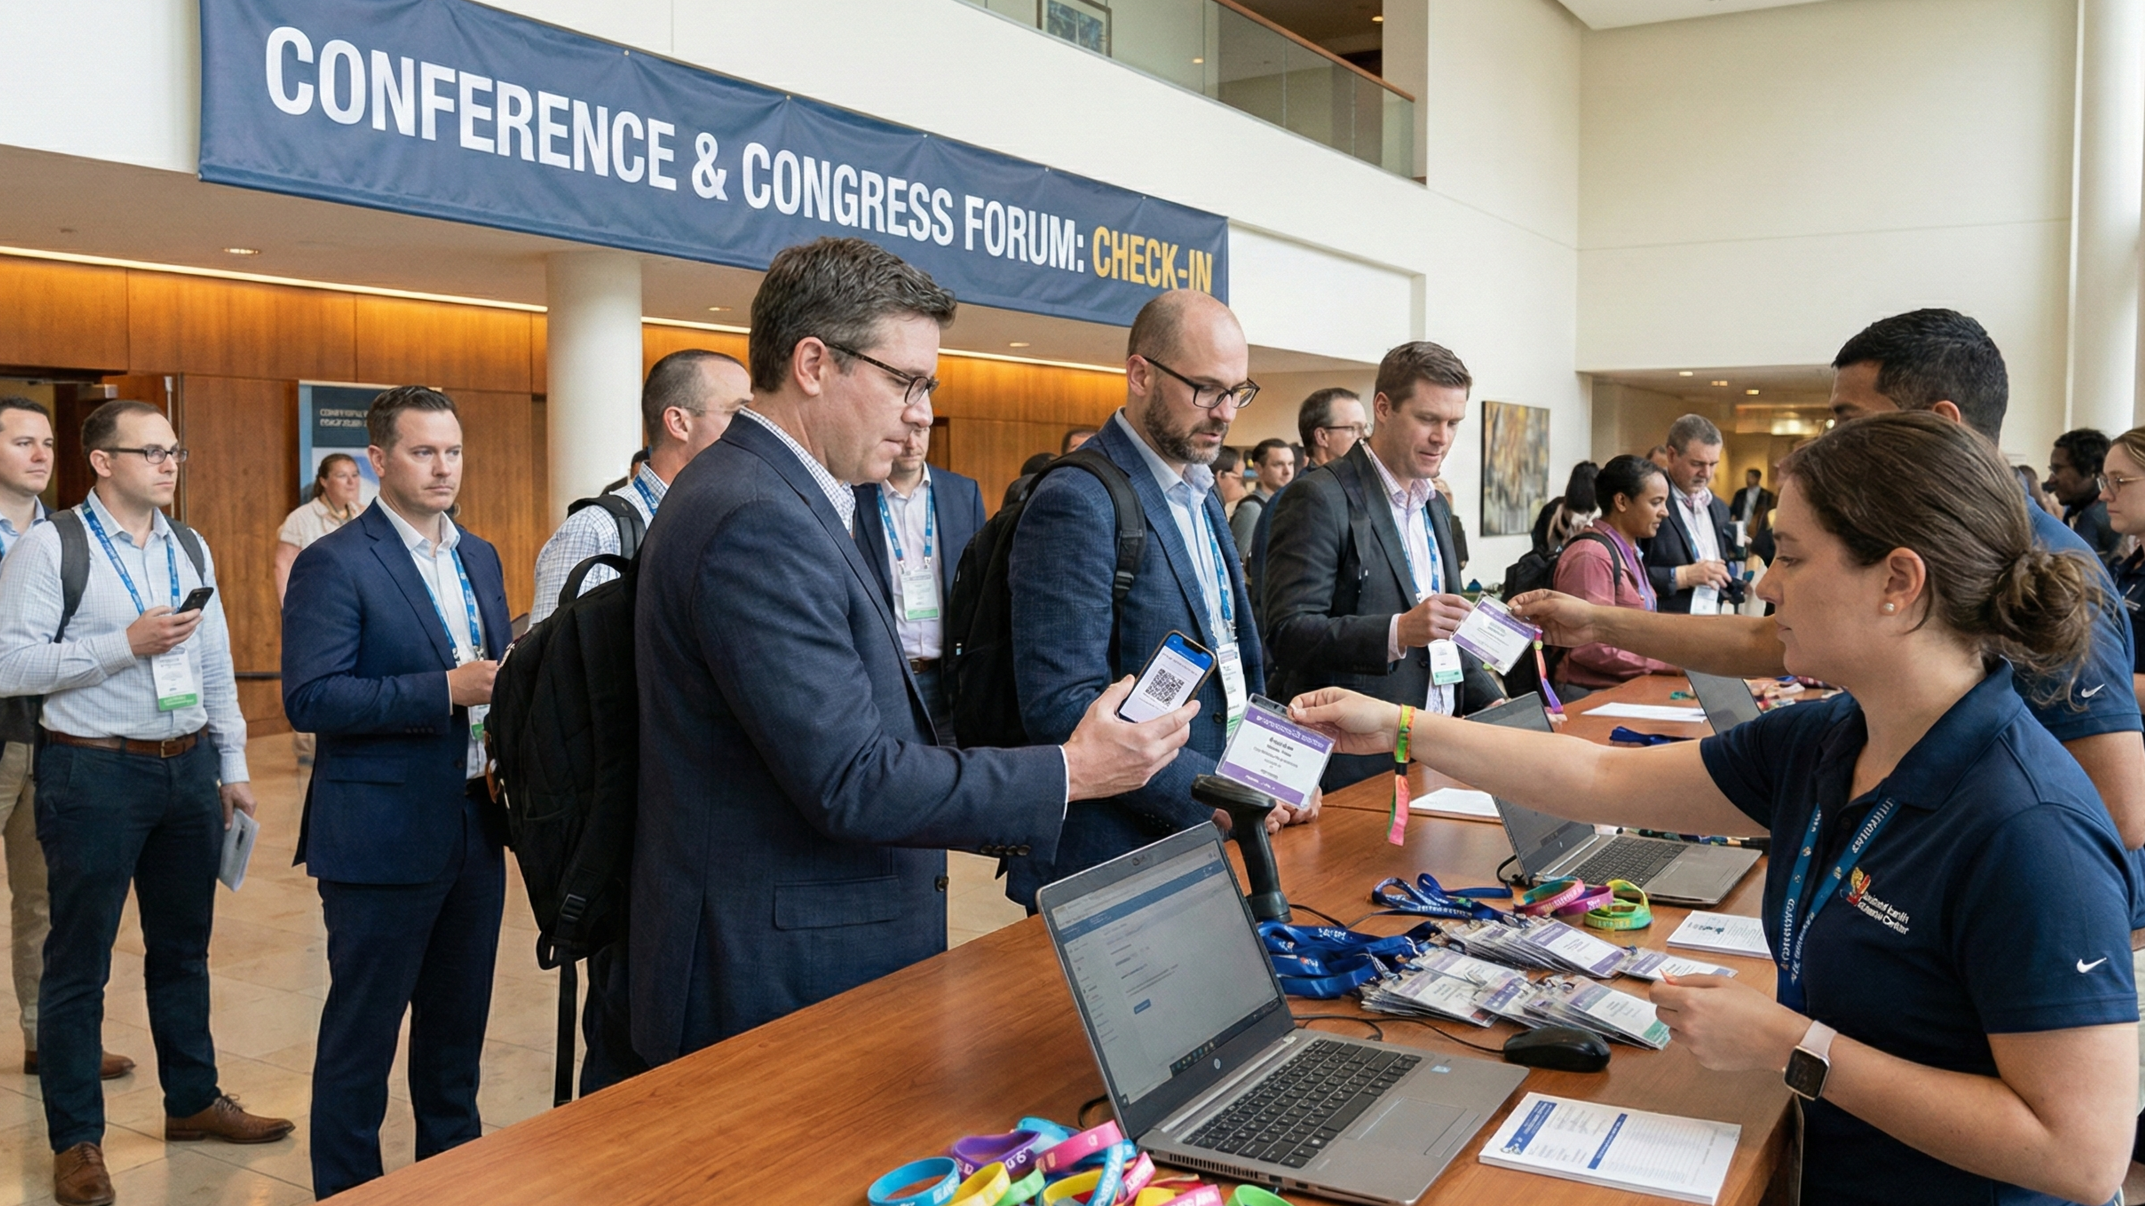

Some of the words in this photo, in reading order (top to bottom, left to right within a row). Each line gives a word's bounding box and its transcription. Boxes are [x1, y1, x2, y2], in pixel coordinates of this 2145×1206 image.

[265, 25, 678, 192] CONFERENCE
[690, 131, 729, 202] &
[741, 141, 955, 247] CONGRESS
[964, 194, 1085, 273] FORUM:
[1092, 226, 1212, 294] CHECK-IN
